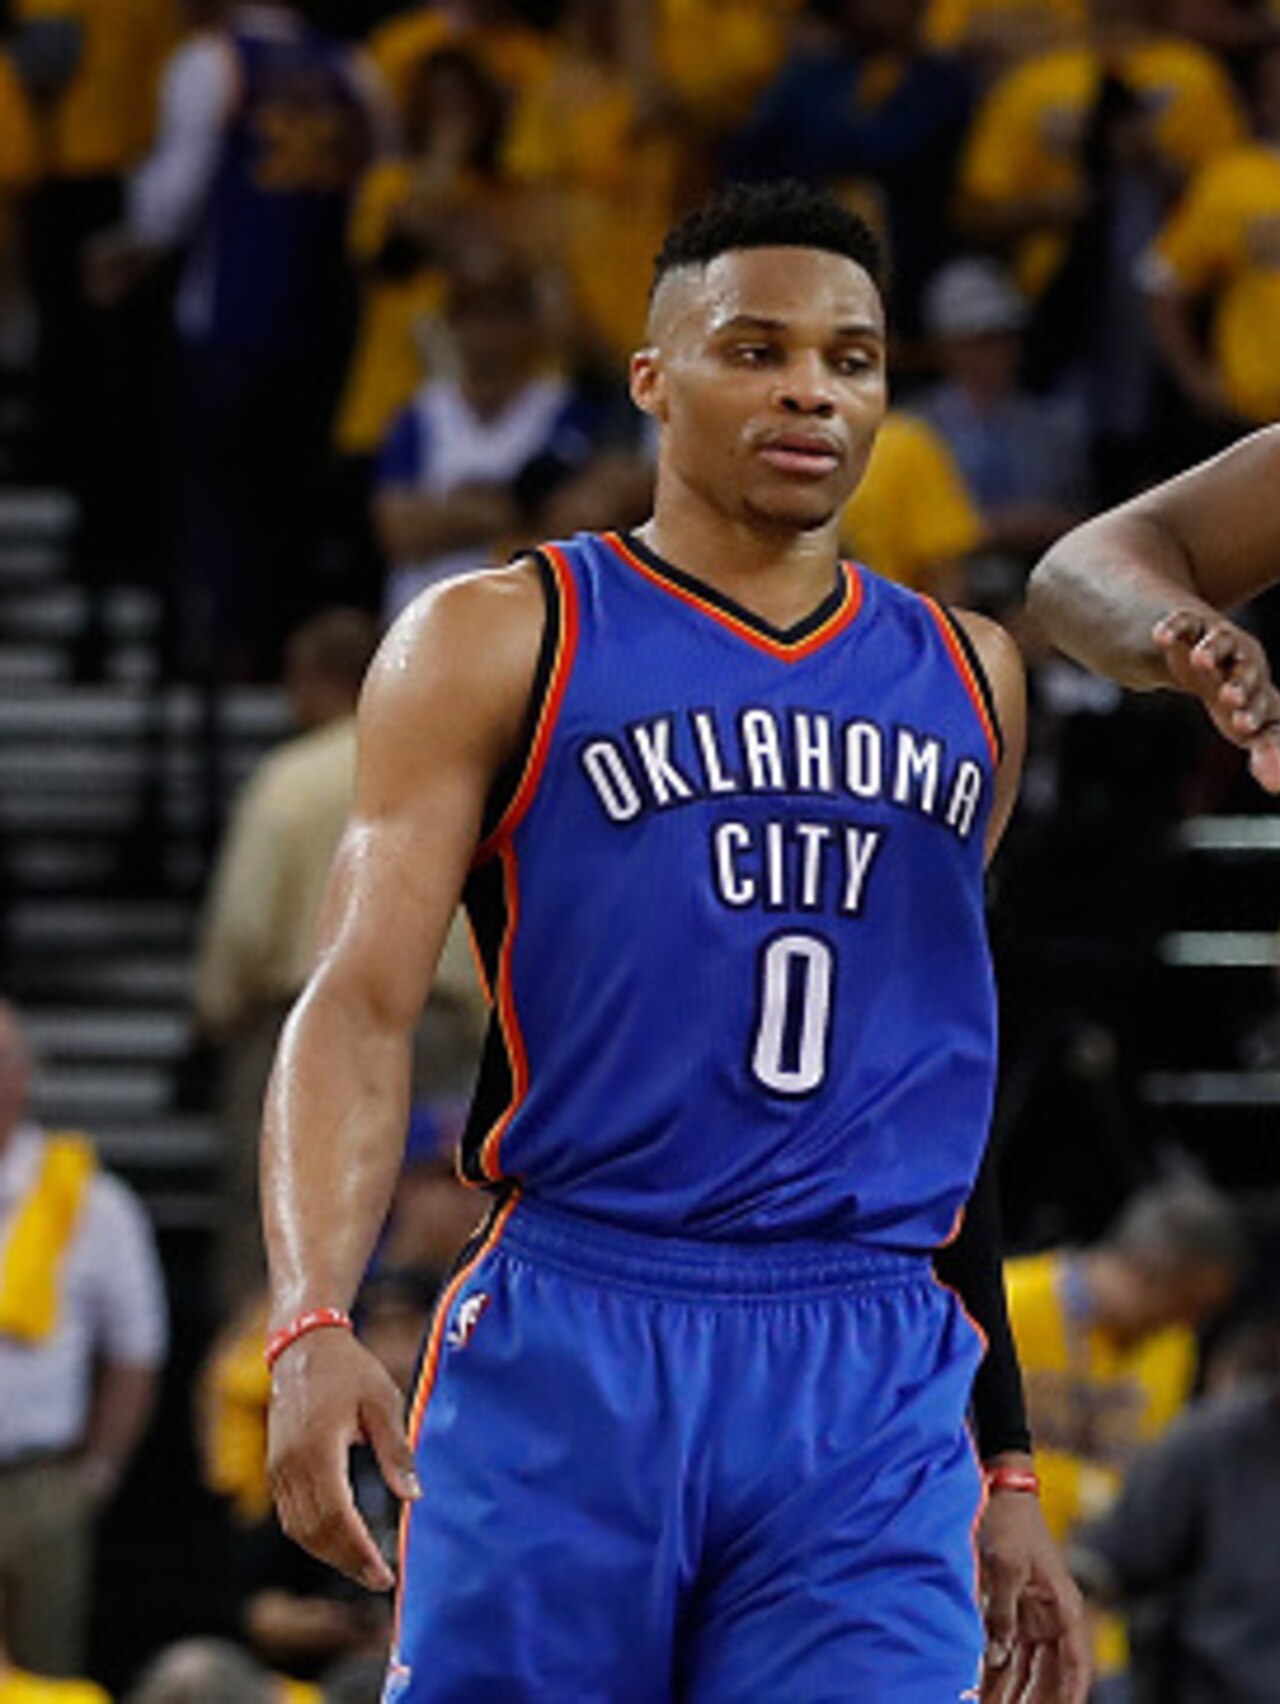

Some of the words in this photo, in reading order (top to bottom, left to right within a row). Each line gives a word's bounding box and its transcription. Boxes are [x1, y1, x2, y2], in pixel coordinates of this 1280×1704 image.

[583, 708, 983, 837] OKLAHOMA
[714, 822, 879, 911] CITY
[751, 934, 832, 1094] 0
